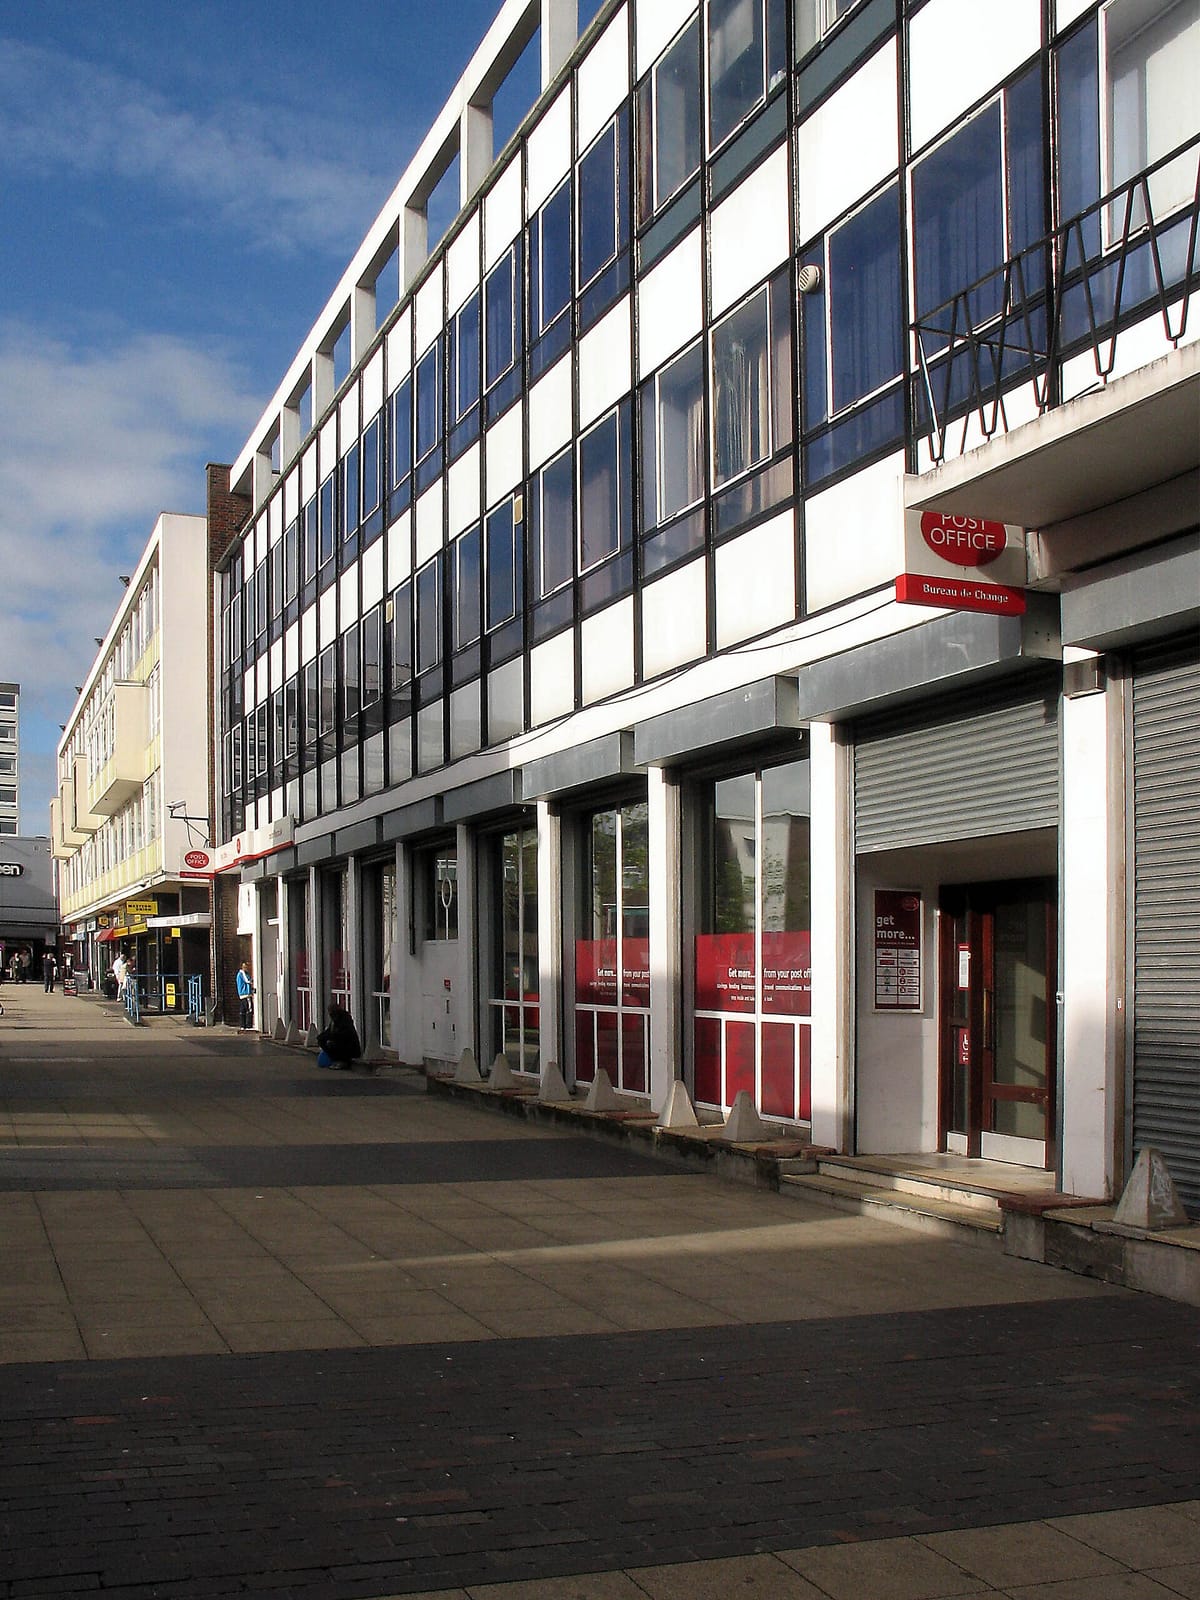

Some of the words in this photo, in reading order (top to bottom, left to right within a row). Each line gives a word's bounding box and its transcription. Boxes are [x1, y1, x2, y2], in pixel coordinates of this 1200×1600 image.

[942, 513, 985, 530] POST
[930, 528, 996, 551] OFFICE
[922, 584, 958, 597] Bureau
[960, 588, 972, 597] de
[974, 590, 1009, 603] Change
[877, 915, 895, 927] get
[877, 930, 915, 940] more...
[763, 967, 777, 978] from
[777, 969, 789, 980] your
[790, 968, 802, 980] post
